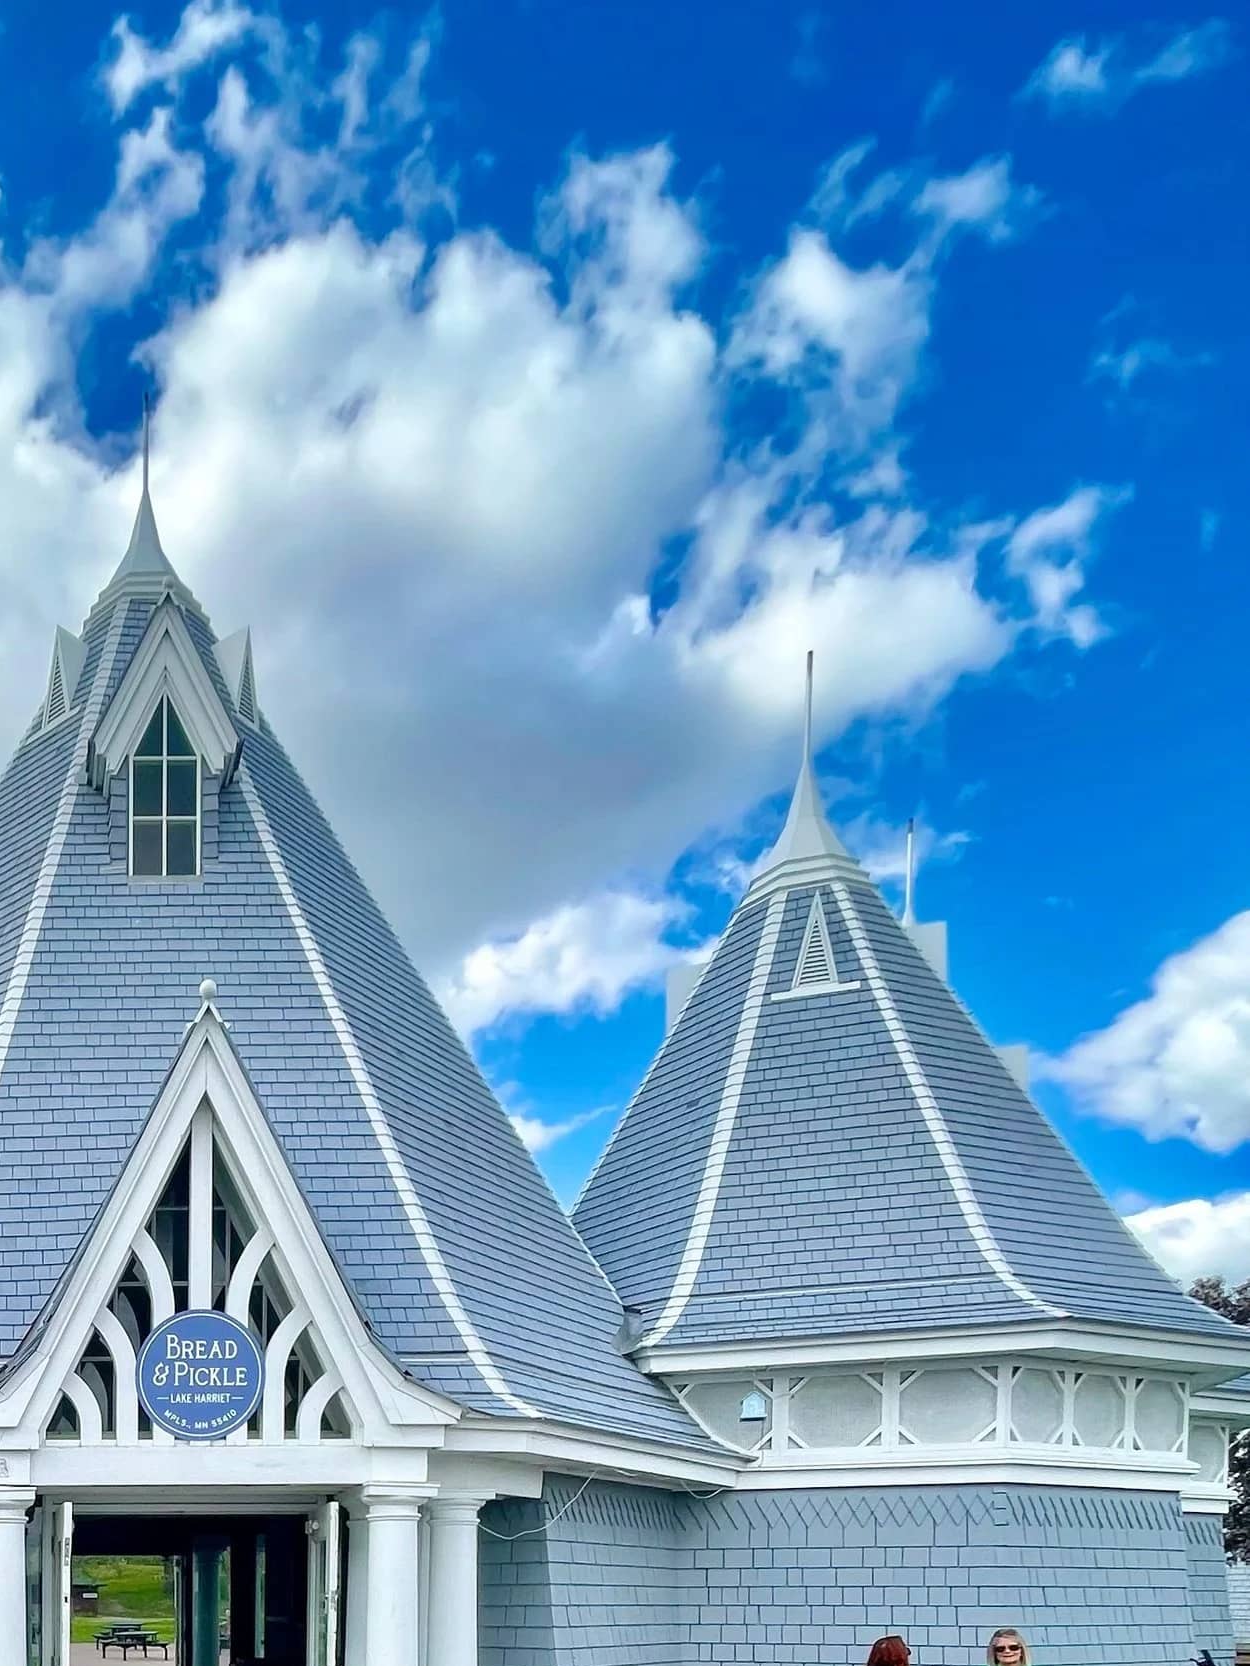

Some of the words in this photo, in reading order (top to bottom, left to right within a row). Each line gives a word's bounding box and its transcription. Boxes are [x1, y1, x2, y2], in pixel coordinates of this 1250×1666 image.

[166, 1334, 238, 1360] BREAD
[152, 1362, 170, 1387] &
[173, 1361, 248, 1387] PICKLE
[170, 1393, 192, 1404] LAKE
[194, 1393, 231, 1404] HARRIET
[194, 1421, 209, 1429] MN
[211, 1409, 237, 1428] 55410
